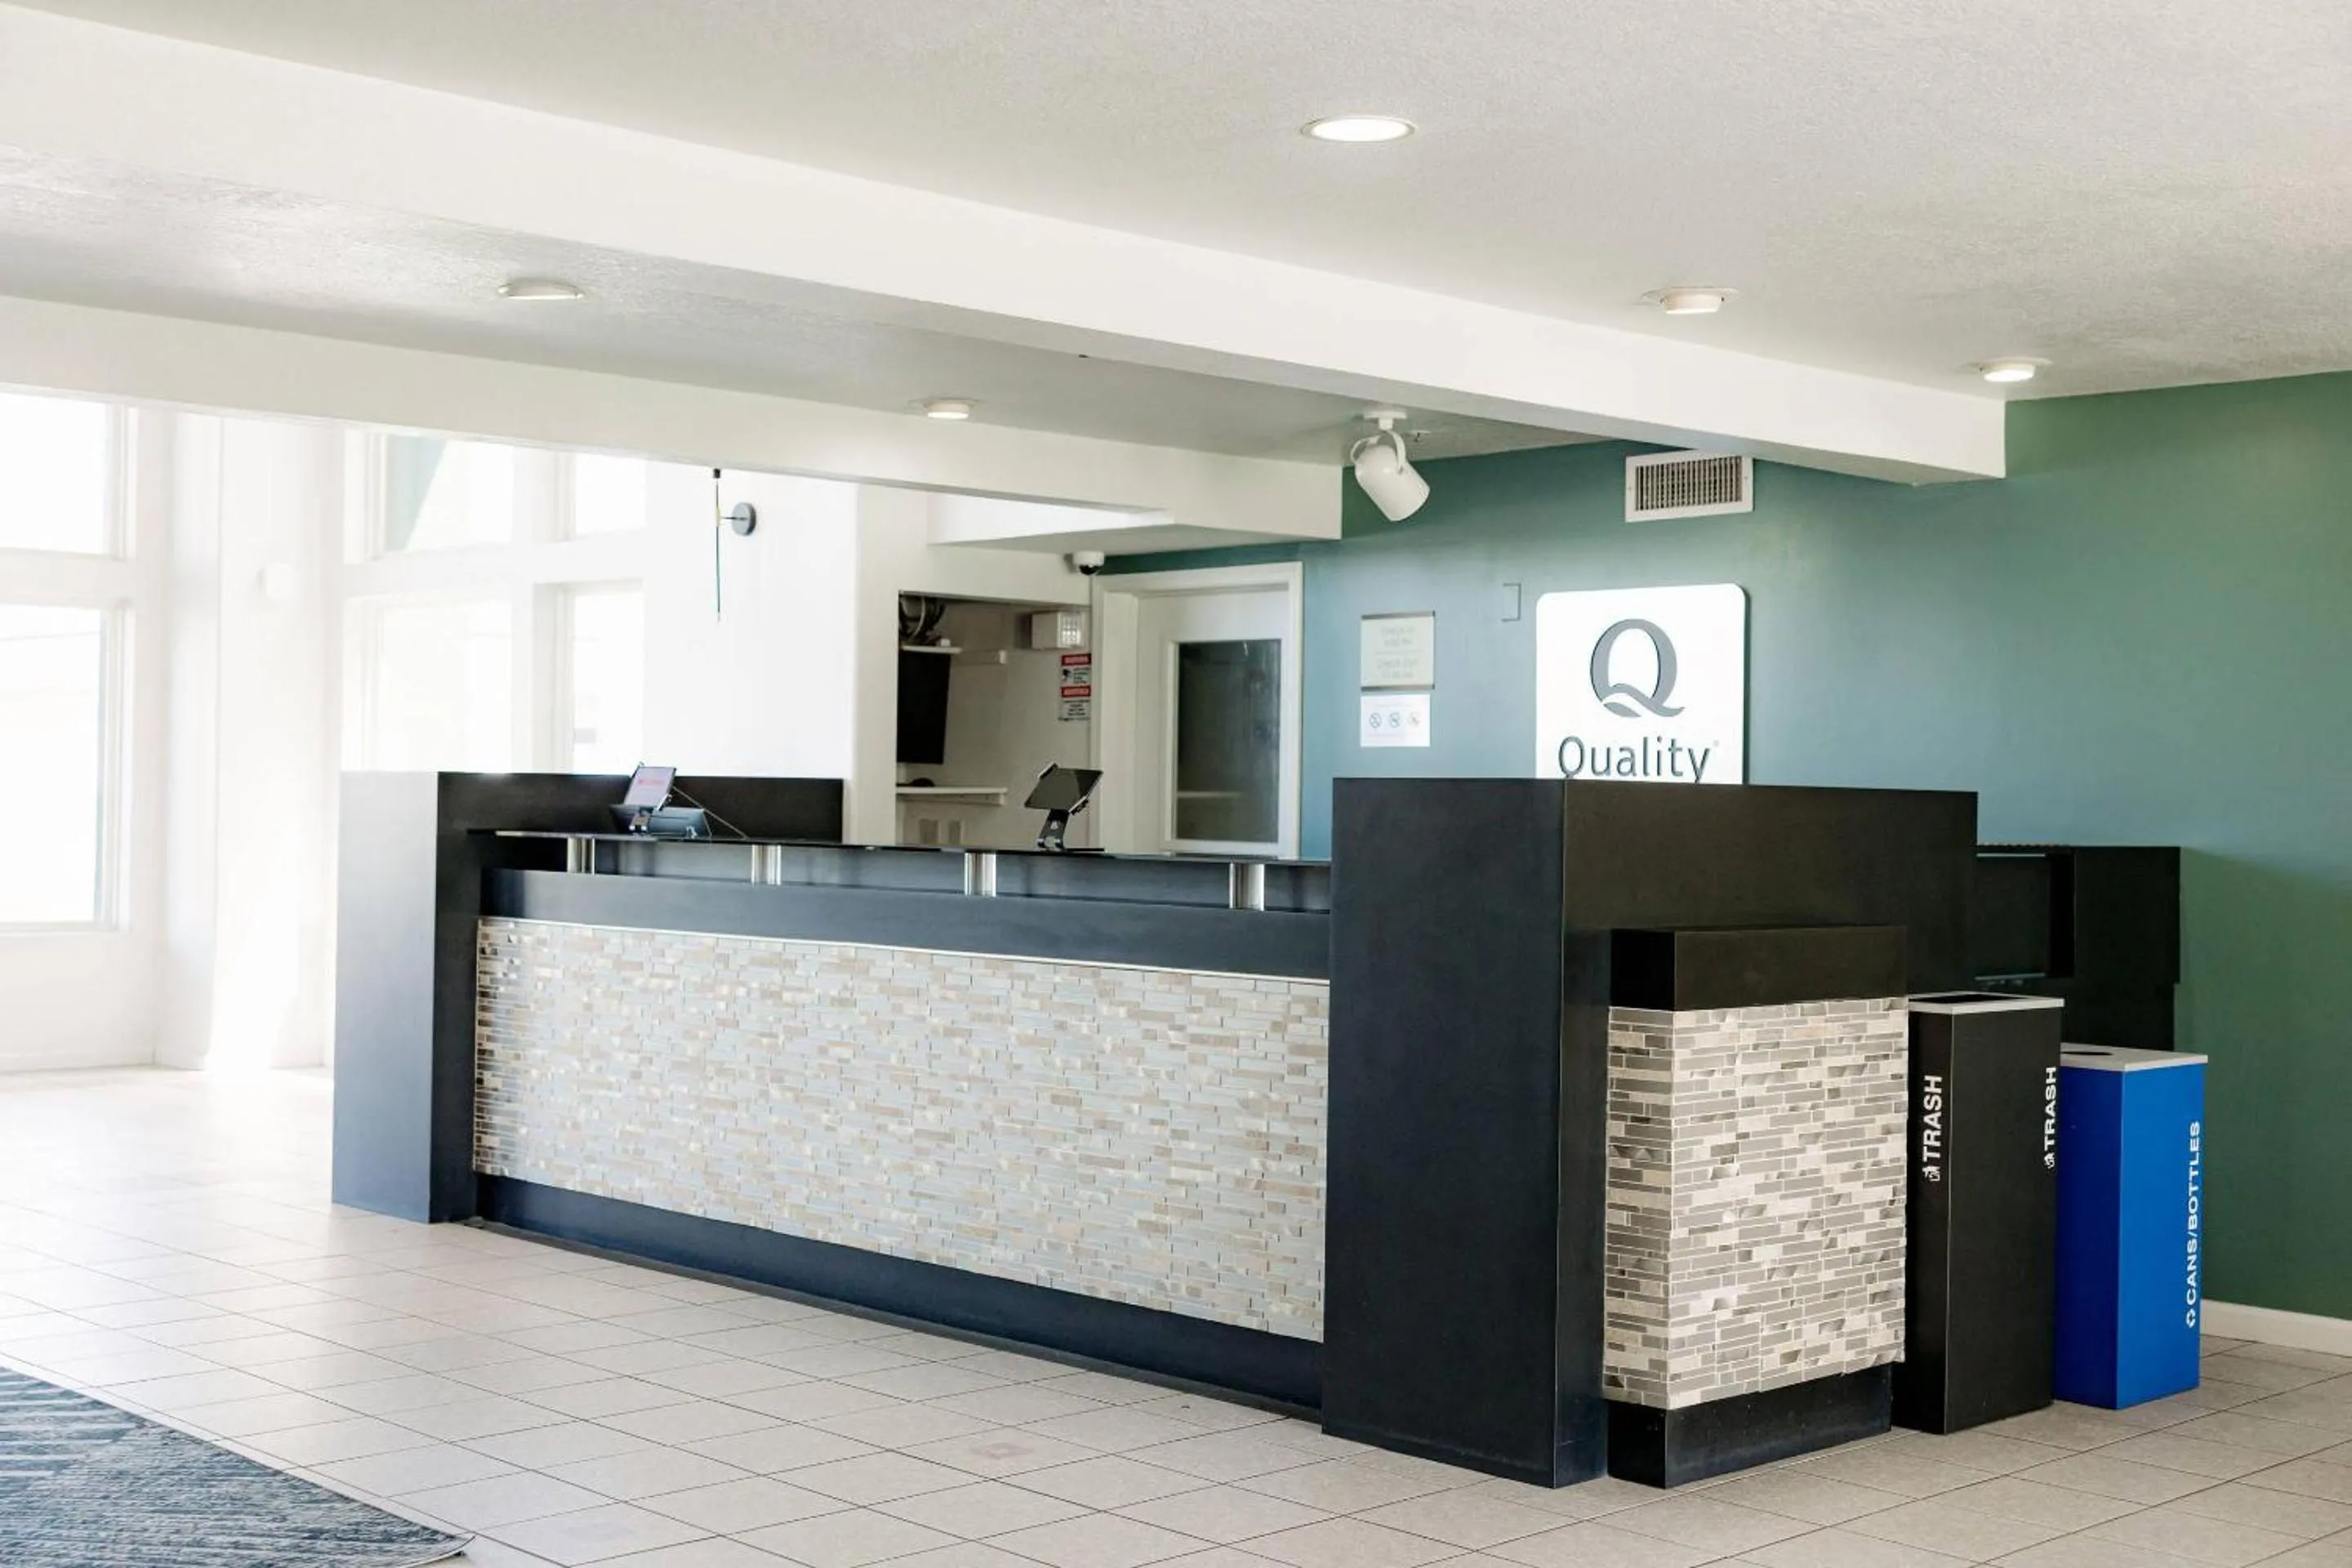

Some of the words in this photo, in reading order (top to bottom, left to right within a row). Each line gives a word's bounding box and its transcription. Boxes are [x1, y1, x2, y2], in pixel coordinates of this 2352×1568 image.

[1589, 618, 1686, 718] Q
[1558, 736, 1711, 782] Quality
[1923, 1075, 1942, 1162] TRASH
[2044, 1067, 2056, 1151] TRASH
[2186, 1121, 2201, 1305] CANS/BOTTLES
